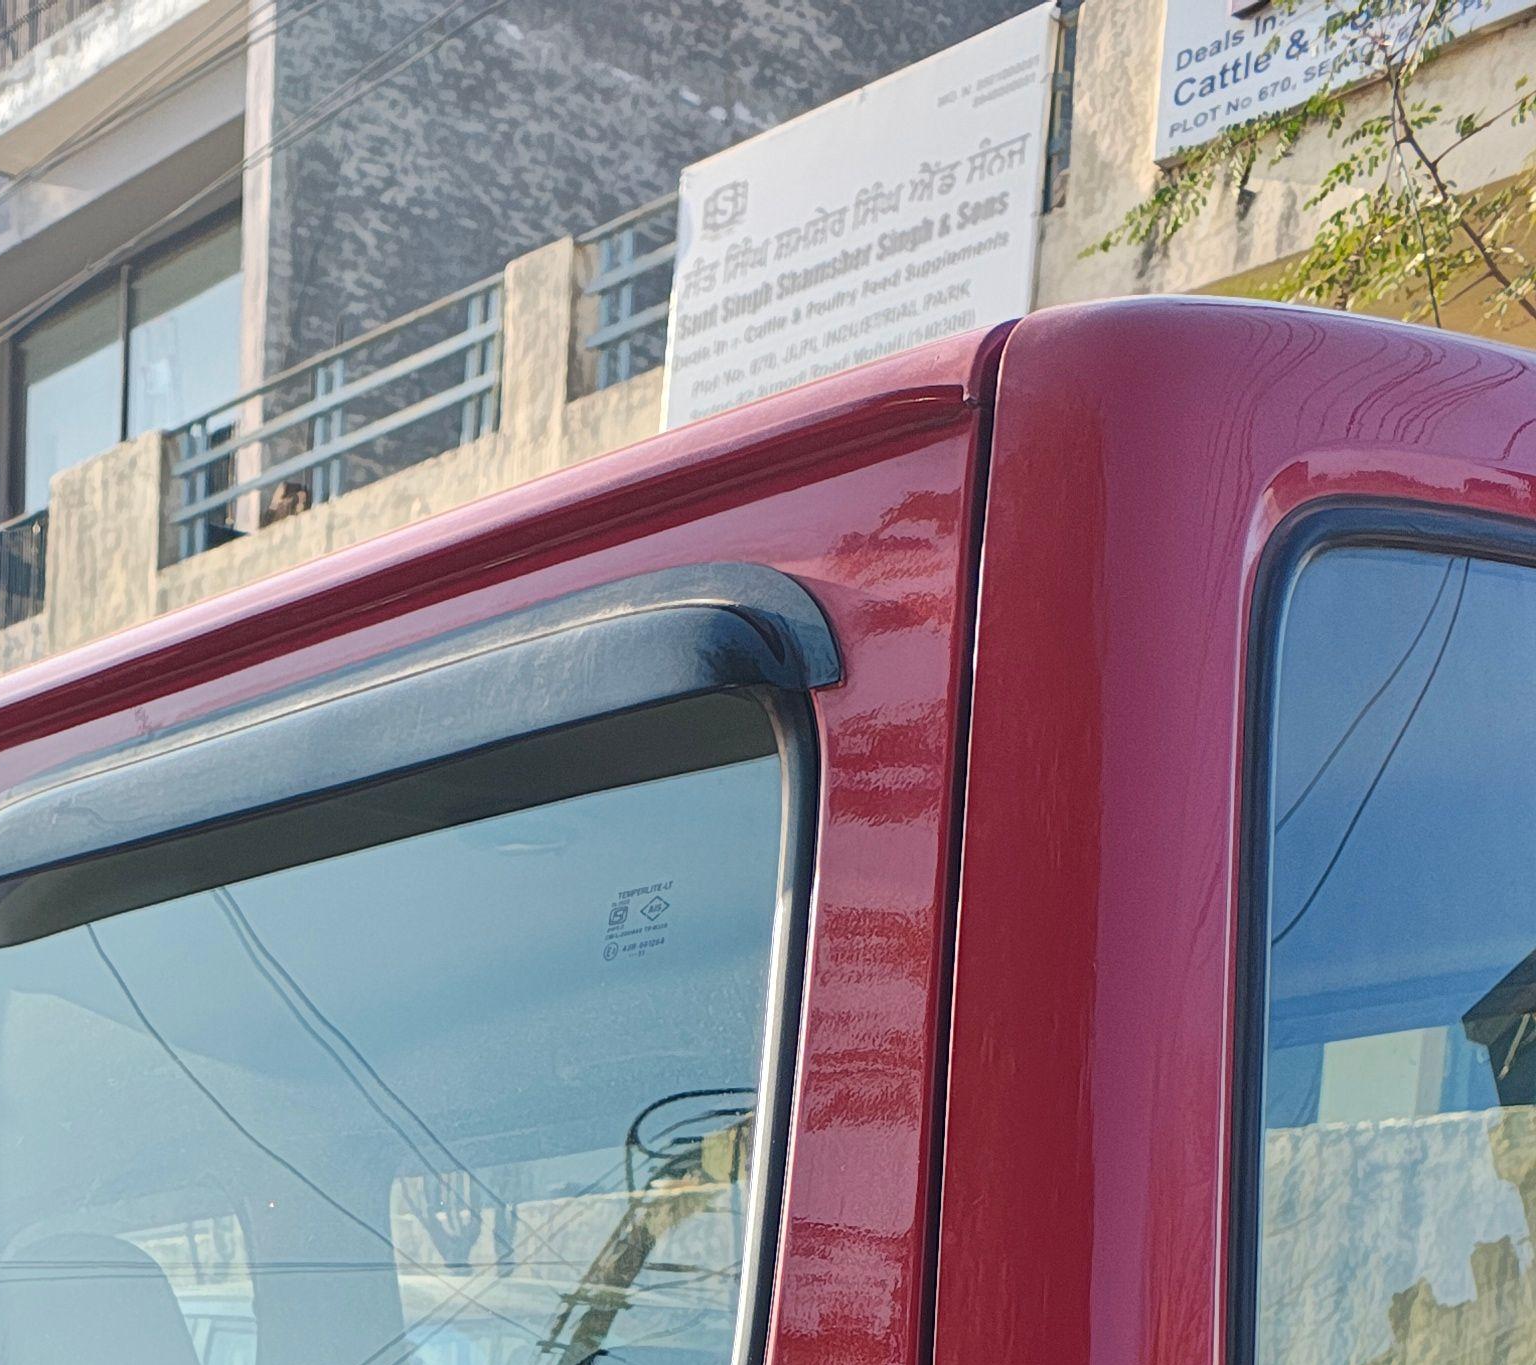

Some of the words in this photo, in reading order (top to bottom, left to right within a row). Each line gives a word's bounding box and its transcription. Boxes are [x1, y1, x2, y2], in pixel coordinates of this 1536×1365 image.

[1174, 51, 1272, 106] Cattle
[1285, 29, 1309, 60] &
[1176, 30, 1244, 71] Deals
[1169, 105, 1221, 138] PLOT
[1225, 97, 1252, 116] No
[721, 281, 772, 322] Singh
[876, 217, 934, 260] Singh
